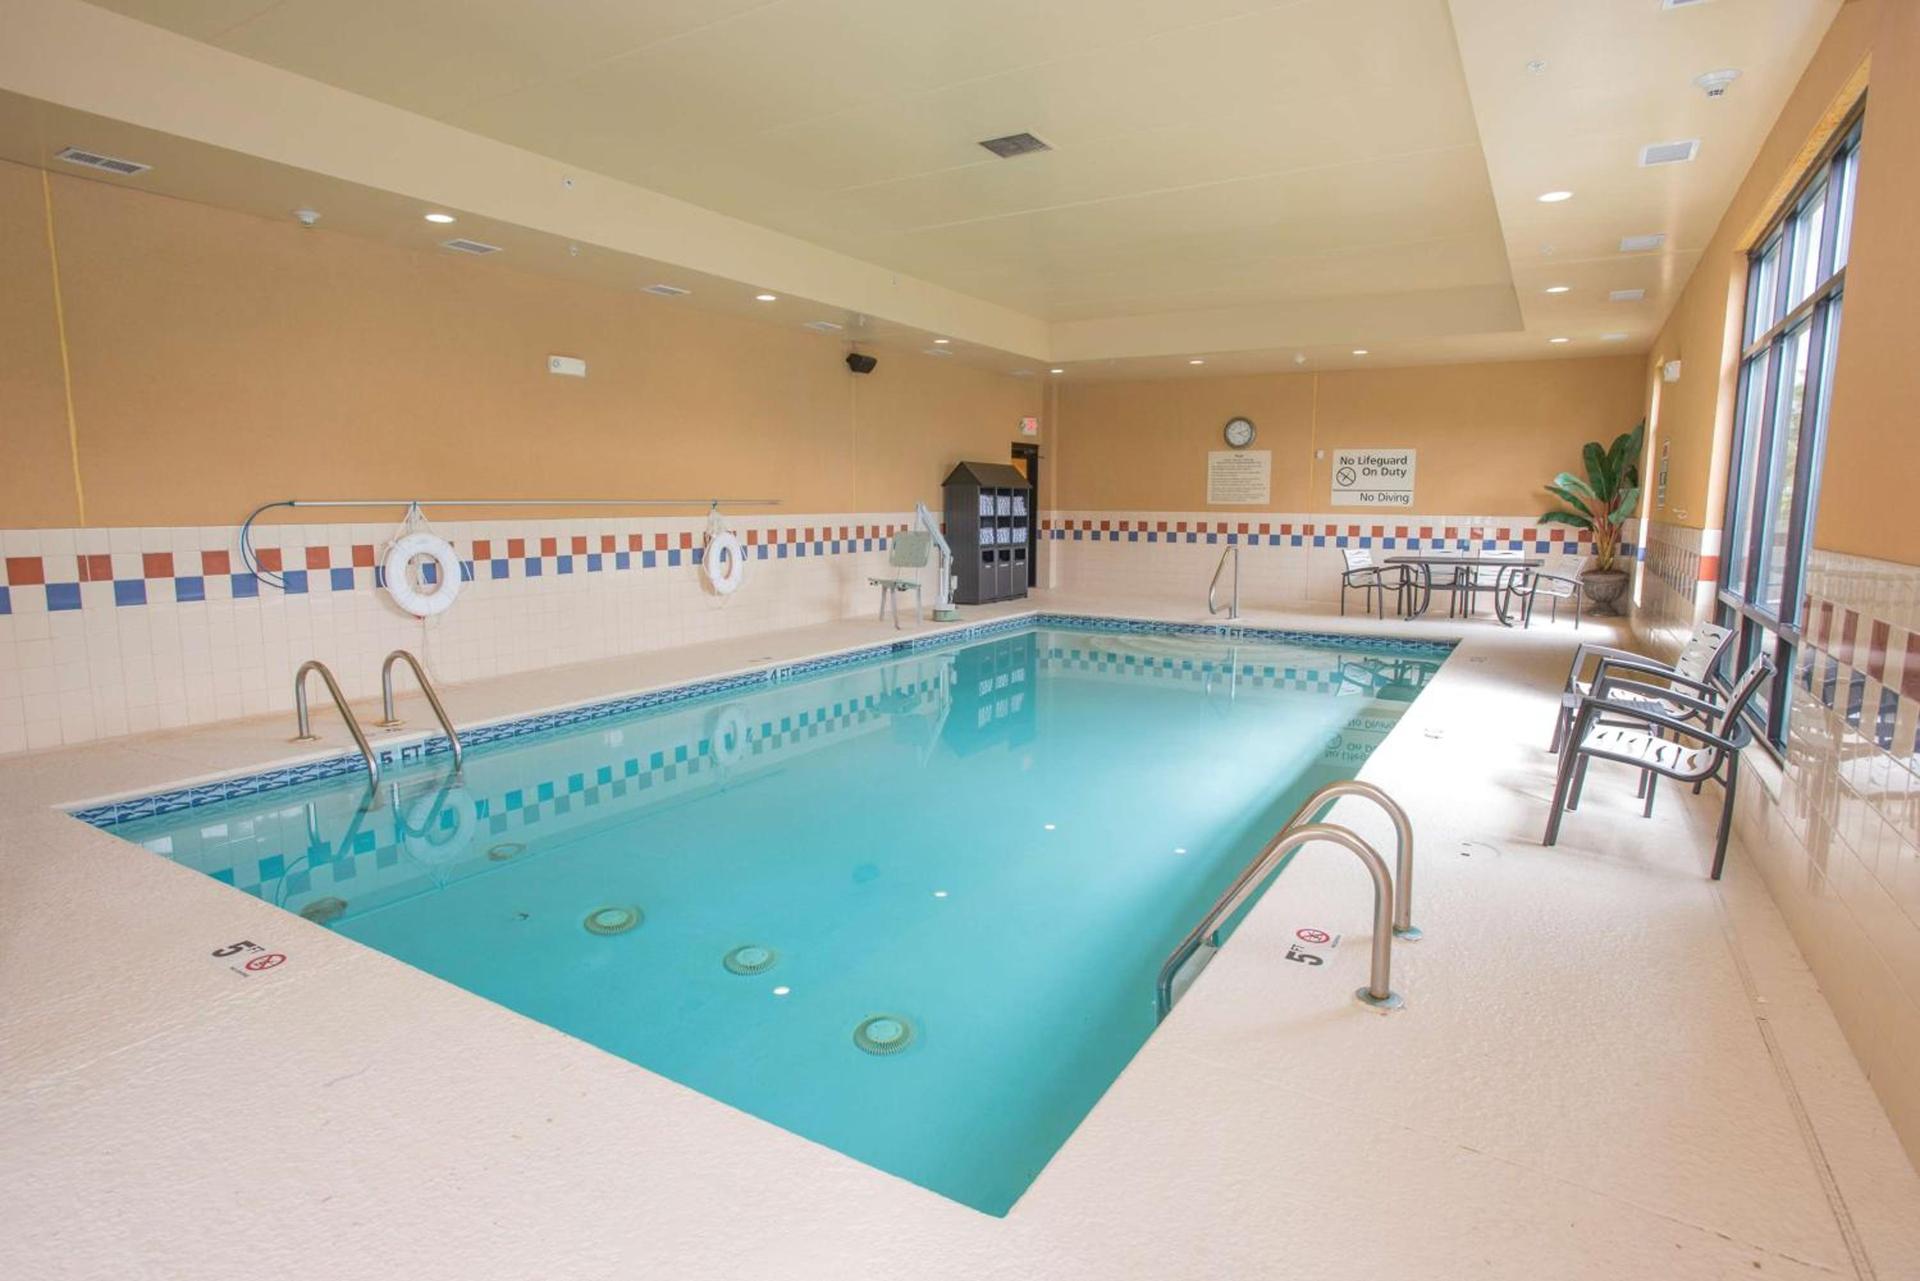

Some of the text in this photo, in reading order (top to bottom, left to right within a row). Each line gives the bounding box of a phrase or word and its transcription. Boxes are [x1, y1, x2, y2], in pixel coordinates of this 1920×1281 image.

[1340, 456, 1408, 467] No Lifeguard
[1362, 467, 1407, 478] On Duty
[1360, 493, 1409, 504] No Diving
[380, 744, 422, 764] 5 FT
[212, 940, 257, 958] 5
[1285, 950, 1324, 966] 5
